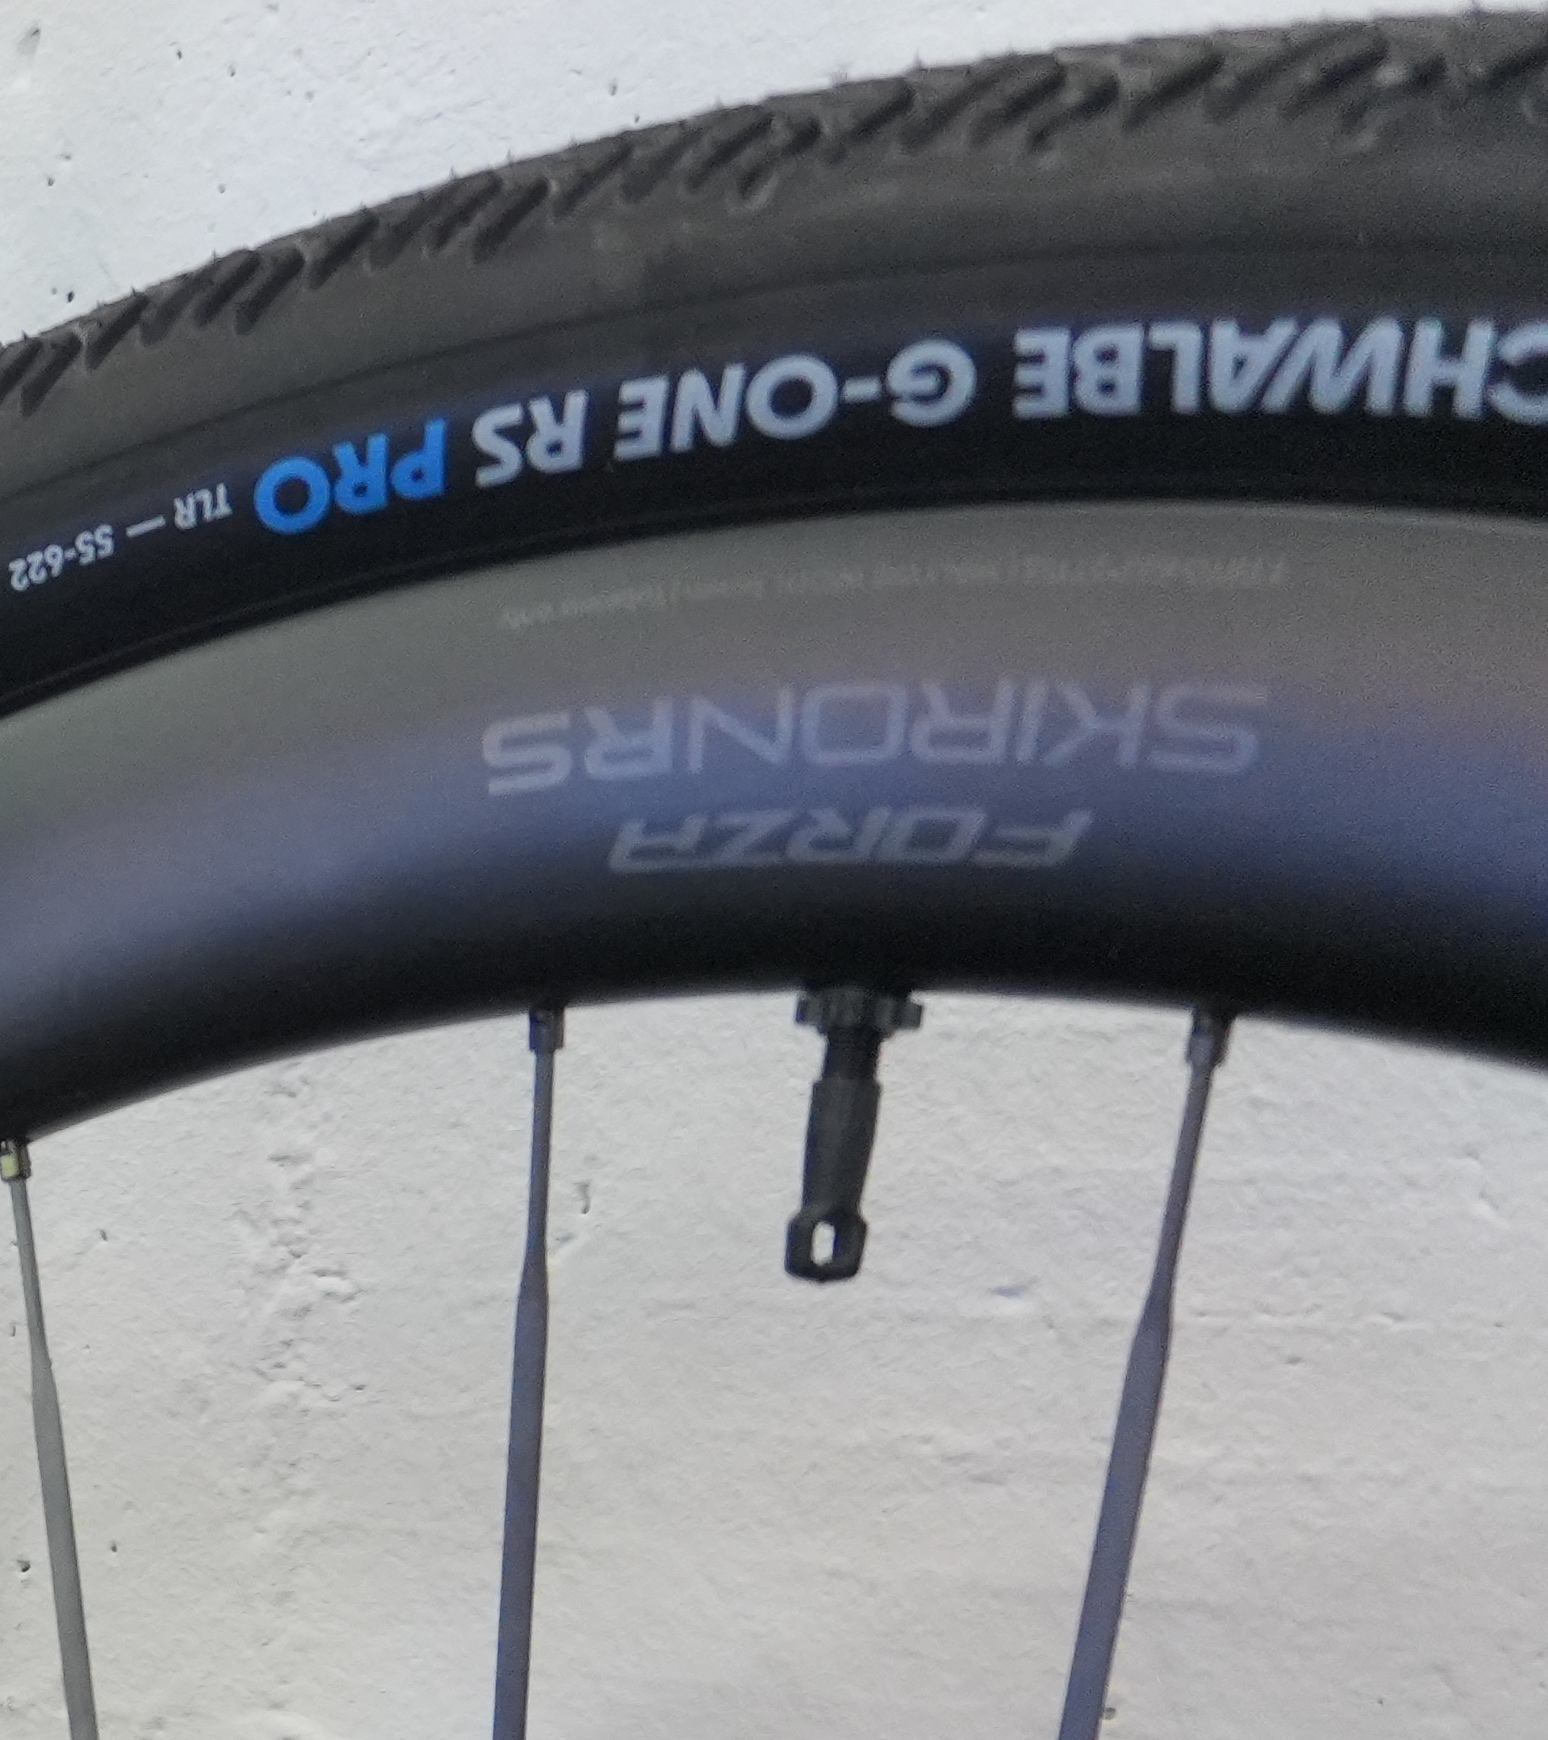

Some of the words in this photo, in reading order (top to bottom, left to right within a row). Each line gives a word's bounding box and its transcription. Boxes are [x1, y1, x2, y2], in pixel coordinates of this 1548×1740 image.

[471, 389, 589, 487] RS
[613, 338, 977, 461] G-ONE
[173, 482, 233, 529] TLR
[253, 418, 448, 535] PRO
[8, 523, 116, 591] 55-622
[606, 804, 1095, 873] FORZA
